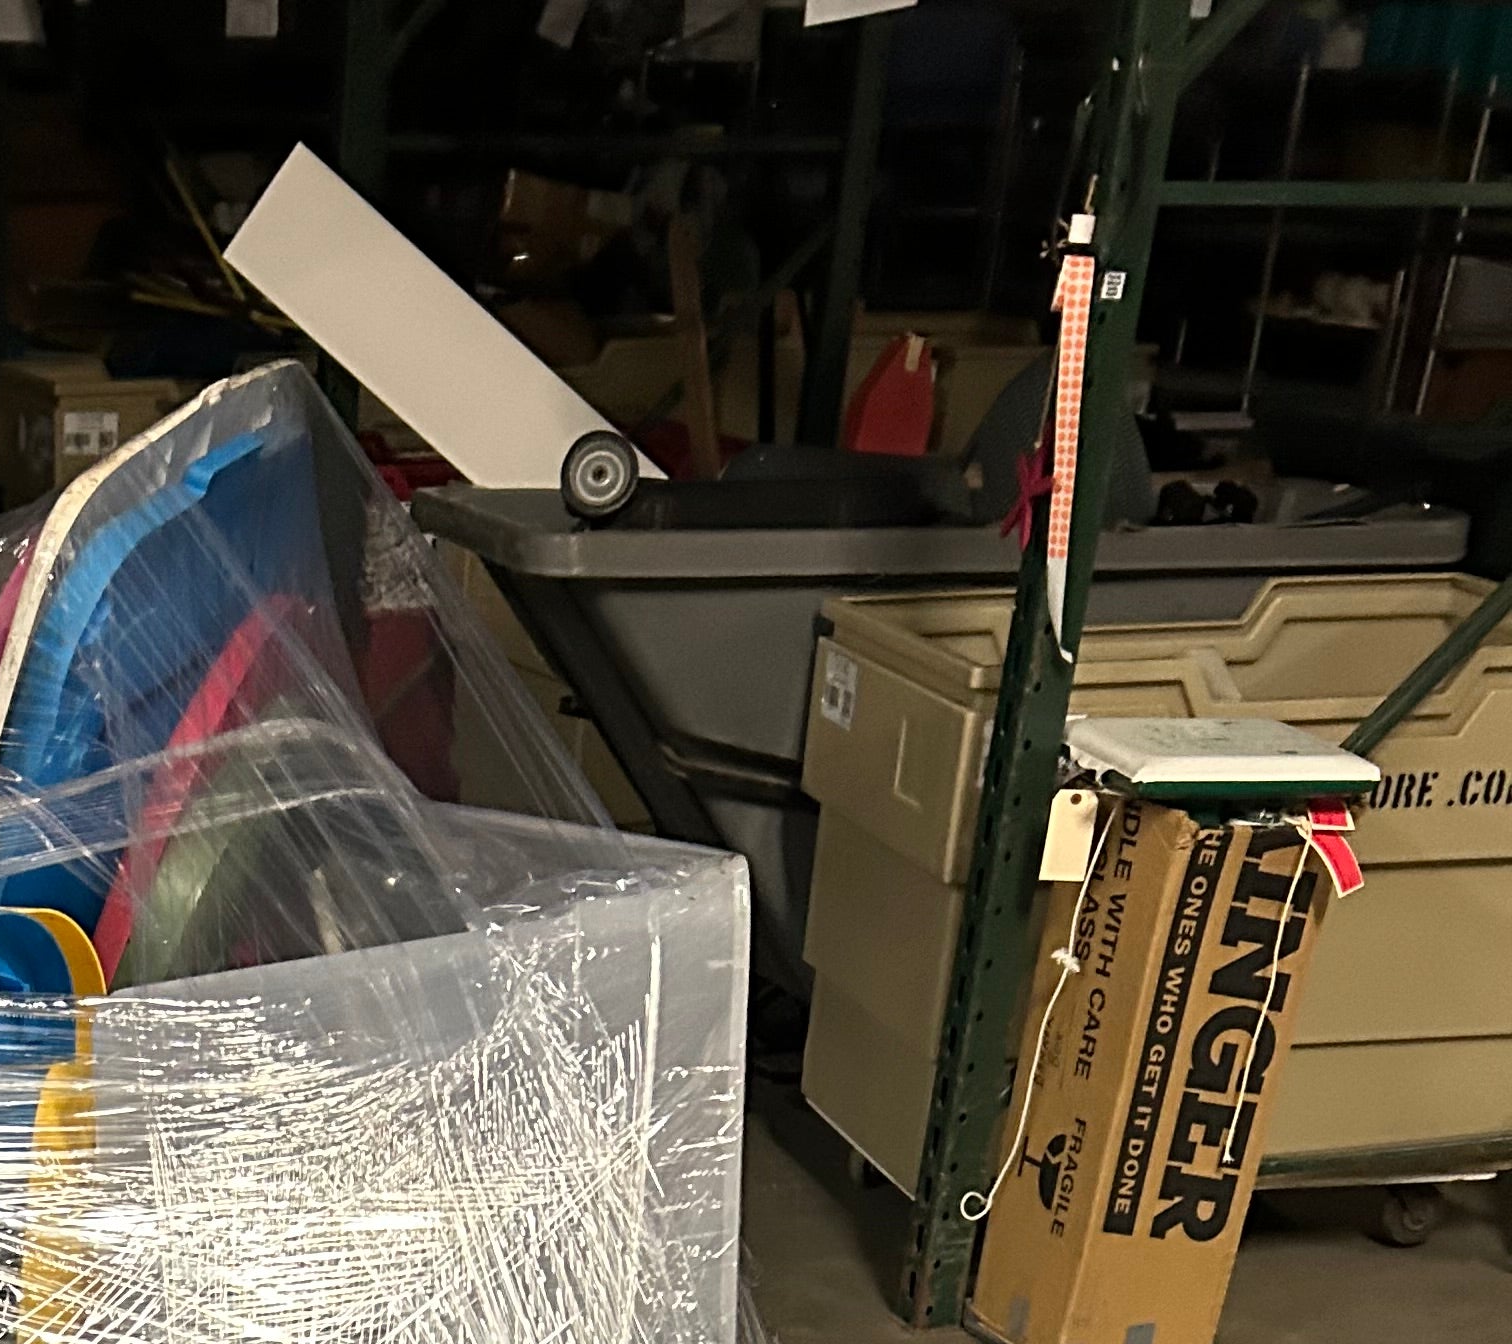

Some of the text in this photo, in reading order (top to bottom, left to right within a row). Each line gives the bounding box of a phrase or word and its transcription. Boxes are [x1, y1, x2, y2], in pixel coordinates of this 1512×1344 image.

[1369, 770, 1512, 808] ORE .CO
[1096, 894, 1127, 977] WITH
[1074, 988, 1106, 1080] CARE
[1113, 828, 1225, 1214] HE ONES WHO GET IT DONE
[1149, 826, 1318, 1242] INGER
[1050, 1117, 1087, 1238] FRAGILE
